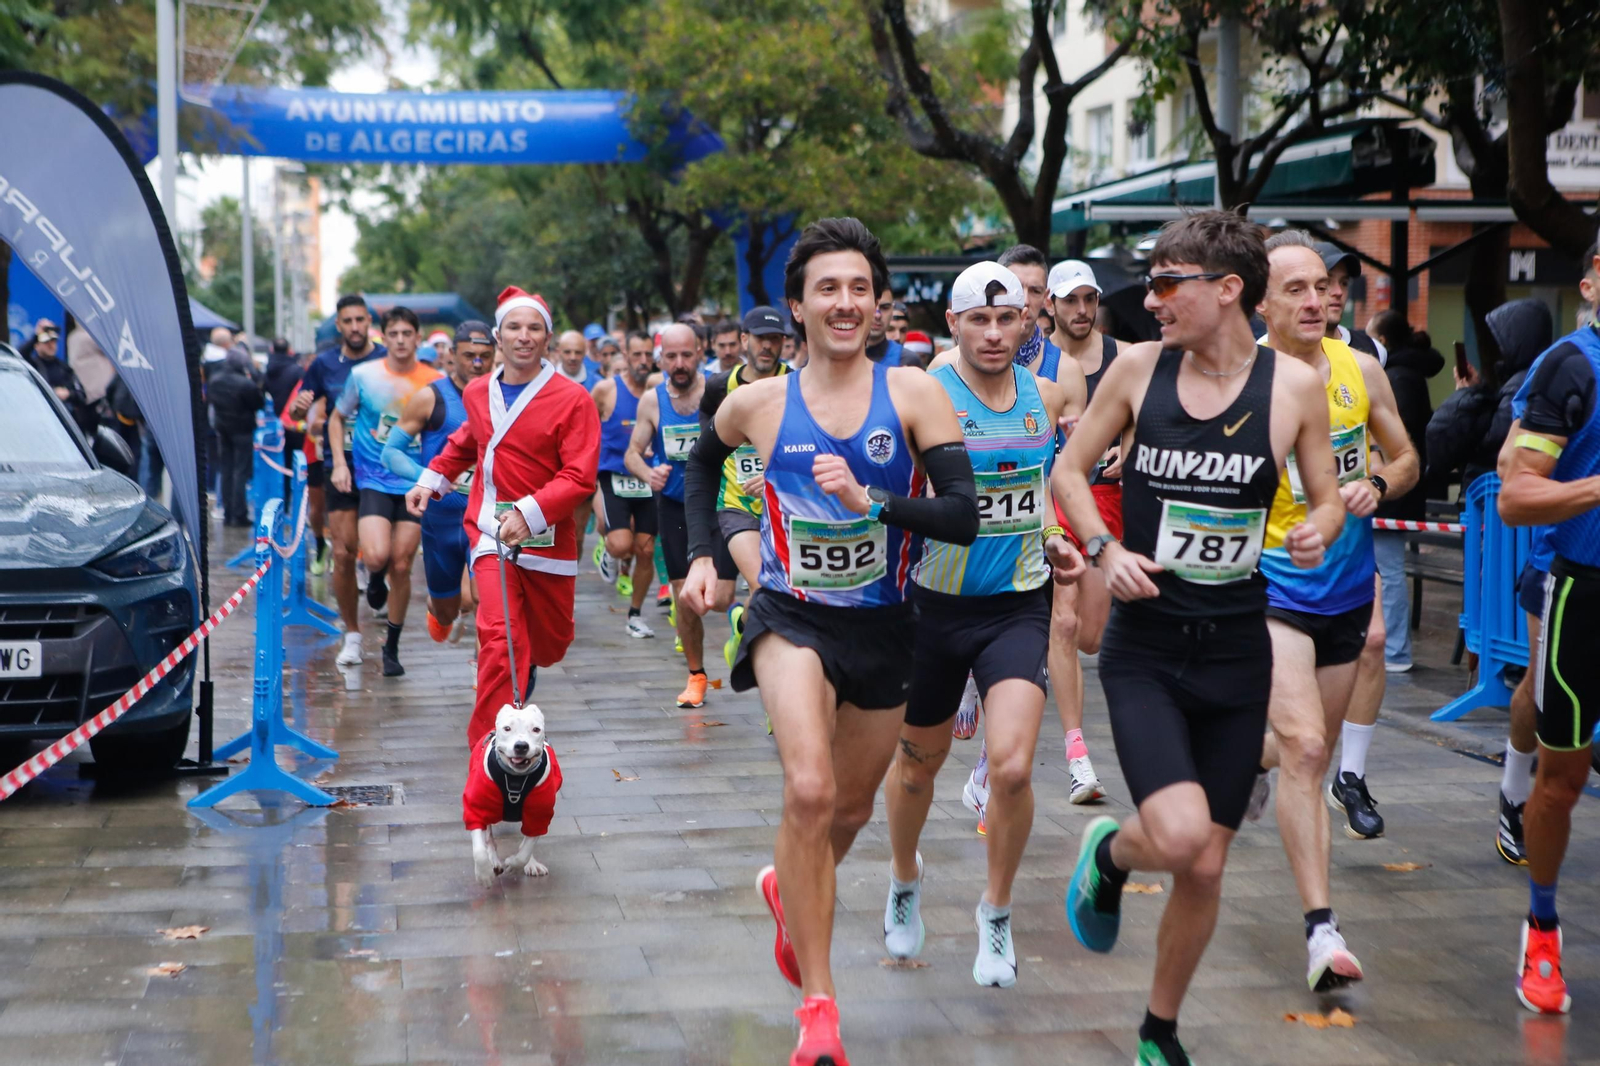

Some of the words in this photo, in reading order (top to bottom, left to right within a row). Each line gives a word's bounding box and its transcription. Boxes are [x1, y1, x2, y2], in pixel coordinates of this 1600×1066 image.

[285, 98, 545, 124] AYUNTAMIENTO
[304, 131, 342, 152] DE
[350, 129, 529, 154] ALGECIRAS
[1509, 250, 1536, 282] M
[784, 444, 816, 454] KAIXO
[1135, 444, 1266, 485] RUN2DAY
[979, 490, 1036, 519] 214
[800, 540, 876, 572] 592
[1171, 530, 1249, 564] 787
